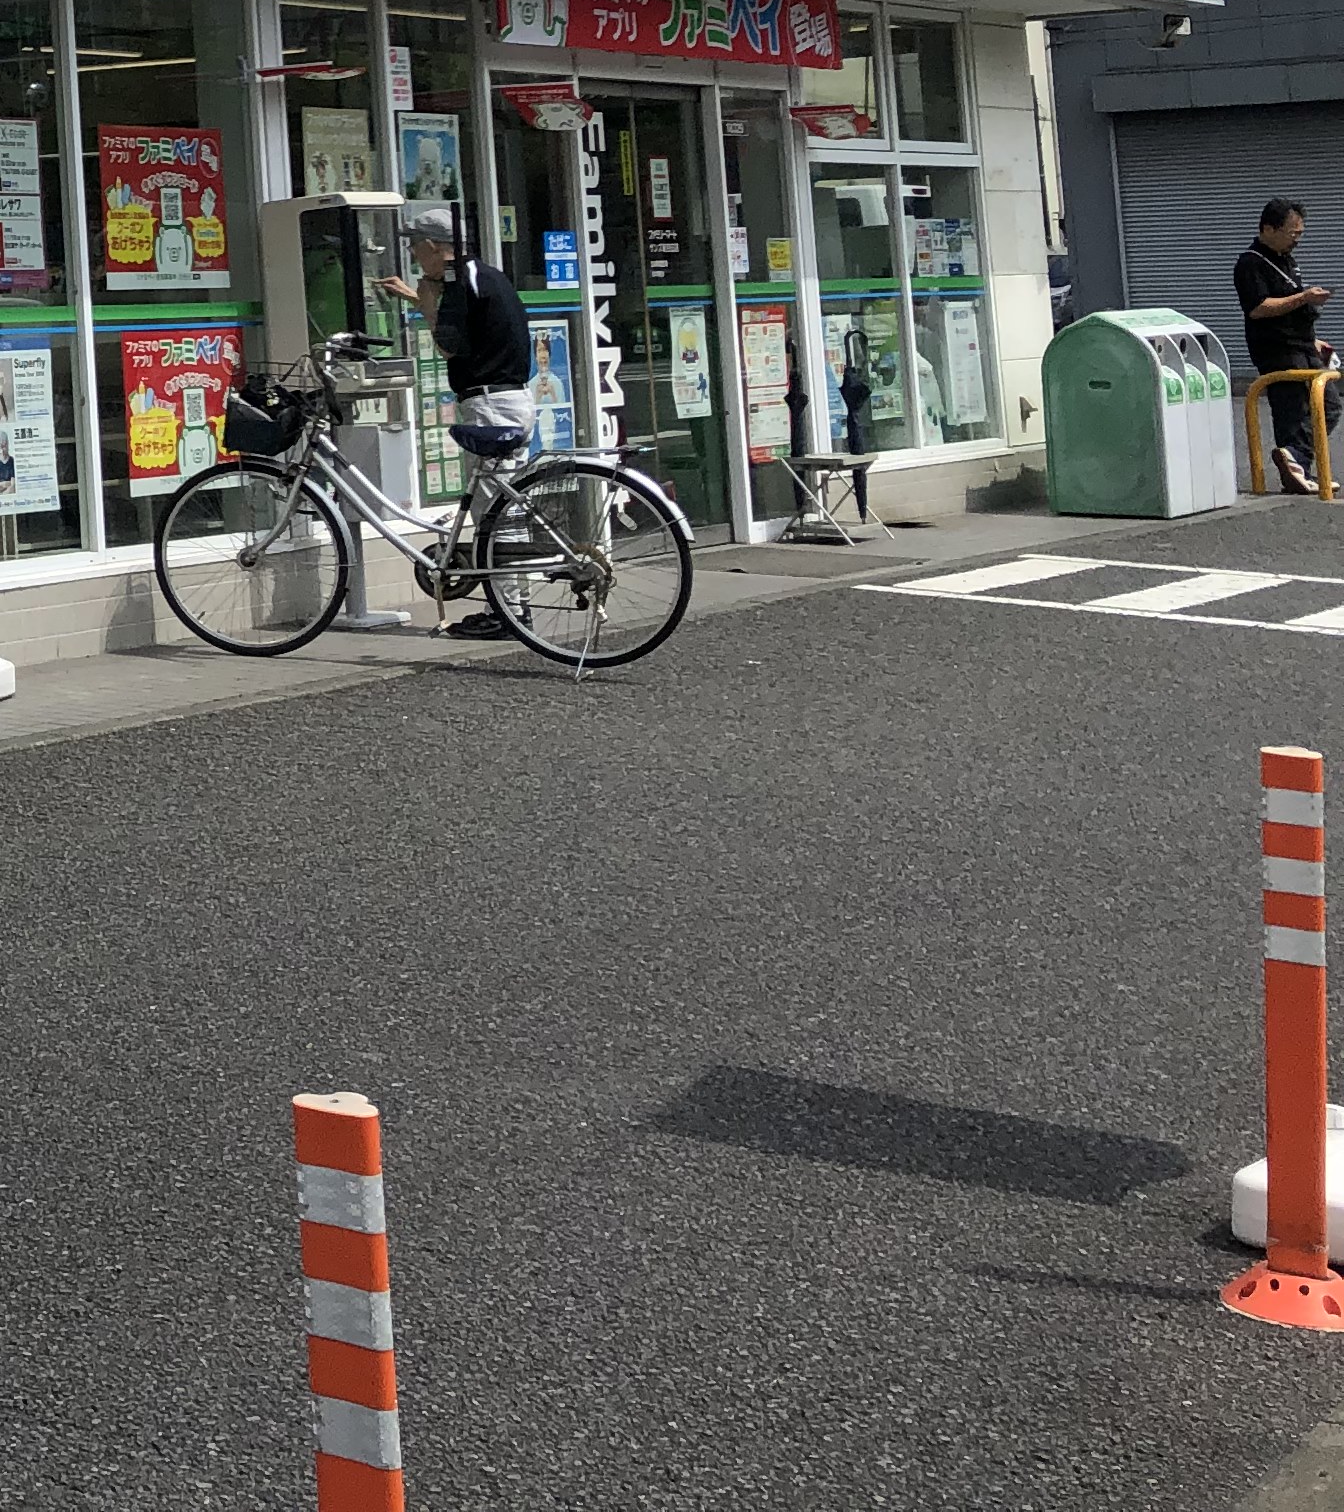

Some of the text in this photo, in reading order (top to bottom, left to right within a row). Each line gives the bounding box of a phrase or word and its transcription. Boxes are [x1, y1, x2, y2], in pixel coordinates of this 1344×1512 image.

[593, 8, 639, 42] アプリ
[789, 0, 834, 58] 登場
[102, 136, 135, 149] ファミマの
[109, 150, 130, 164] アプリ
[136, 135, 199, 166] ファミペイ
[125, 339, 159, 354] ファミマの
[159, 335, 222, 367] ファミペイ
[13, 356, 46, 370] Superfly
[132, 355, 153, 368] アプリ
